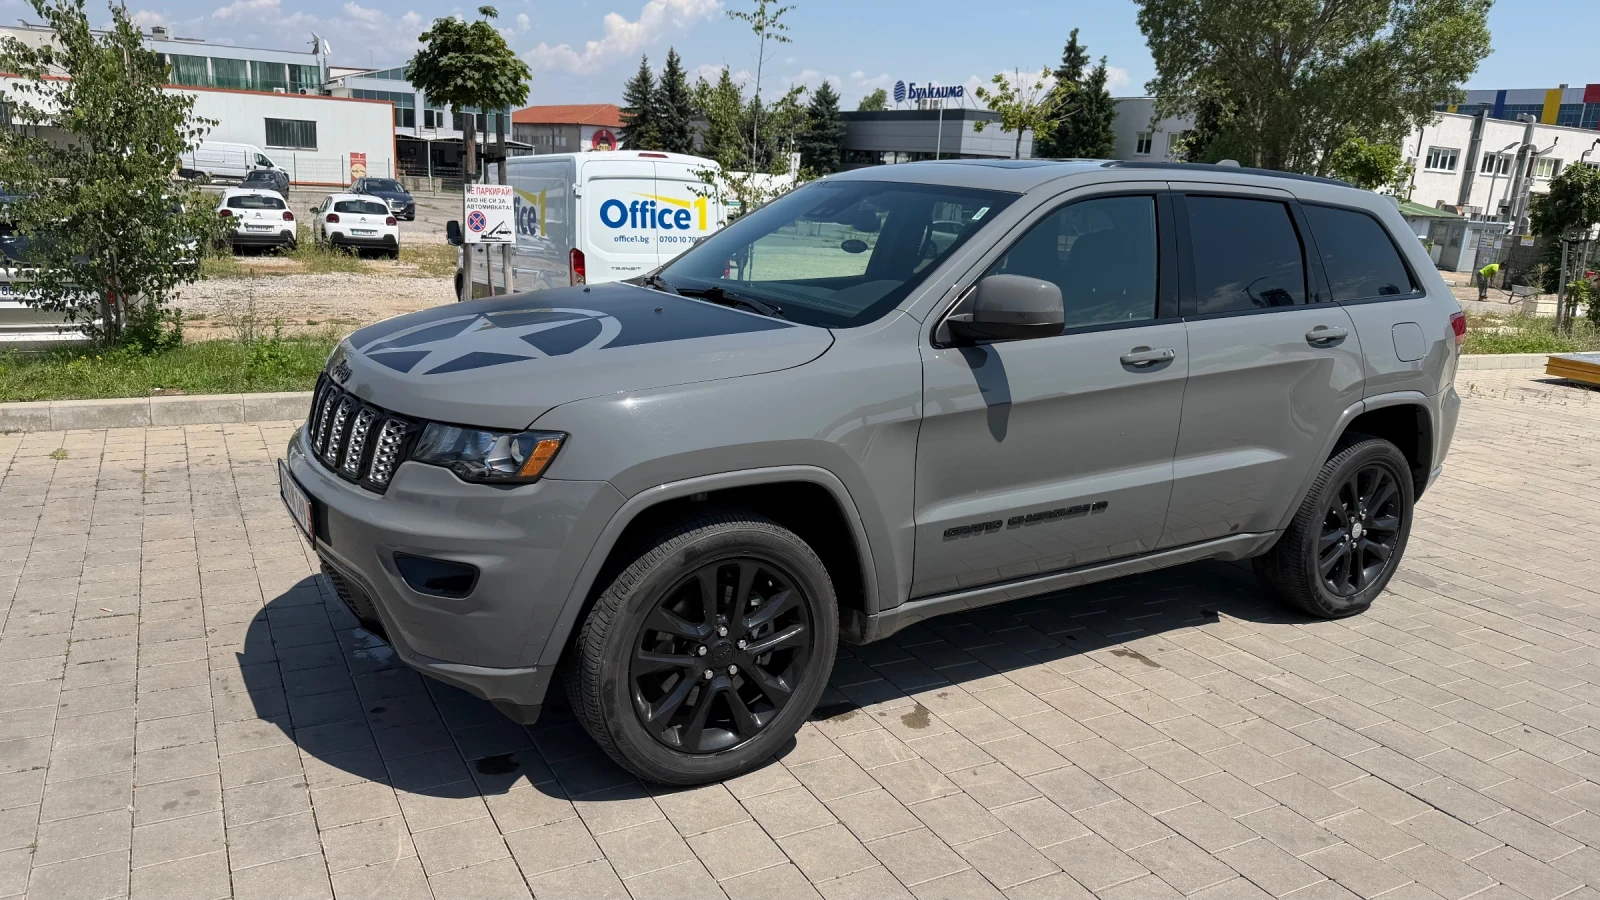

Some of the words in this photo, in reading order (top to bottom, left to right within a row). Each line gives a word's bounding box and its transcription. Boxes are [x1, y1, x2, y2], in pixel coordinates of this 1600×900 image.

[908, 82, 964, 103] Булклима
[466, 185, 474, 195] НЕ
[476, 186, 512, 196] ПАРКИРАЙ!
[613, 235, 650, 244] office1.bg
[943, 519, 1003, 538] GRAND
[1007, 503, 1092, 526] CHEROKEE
